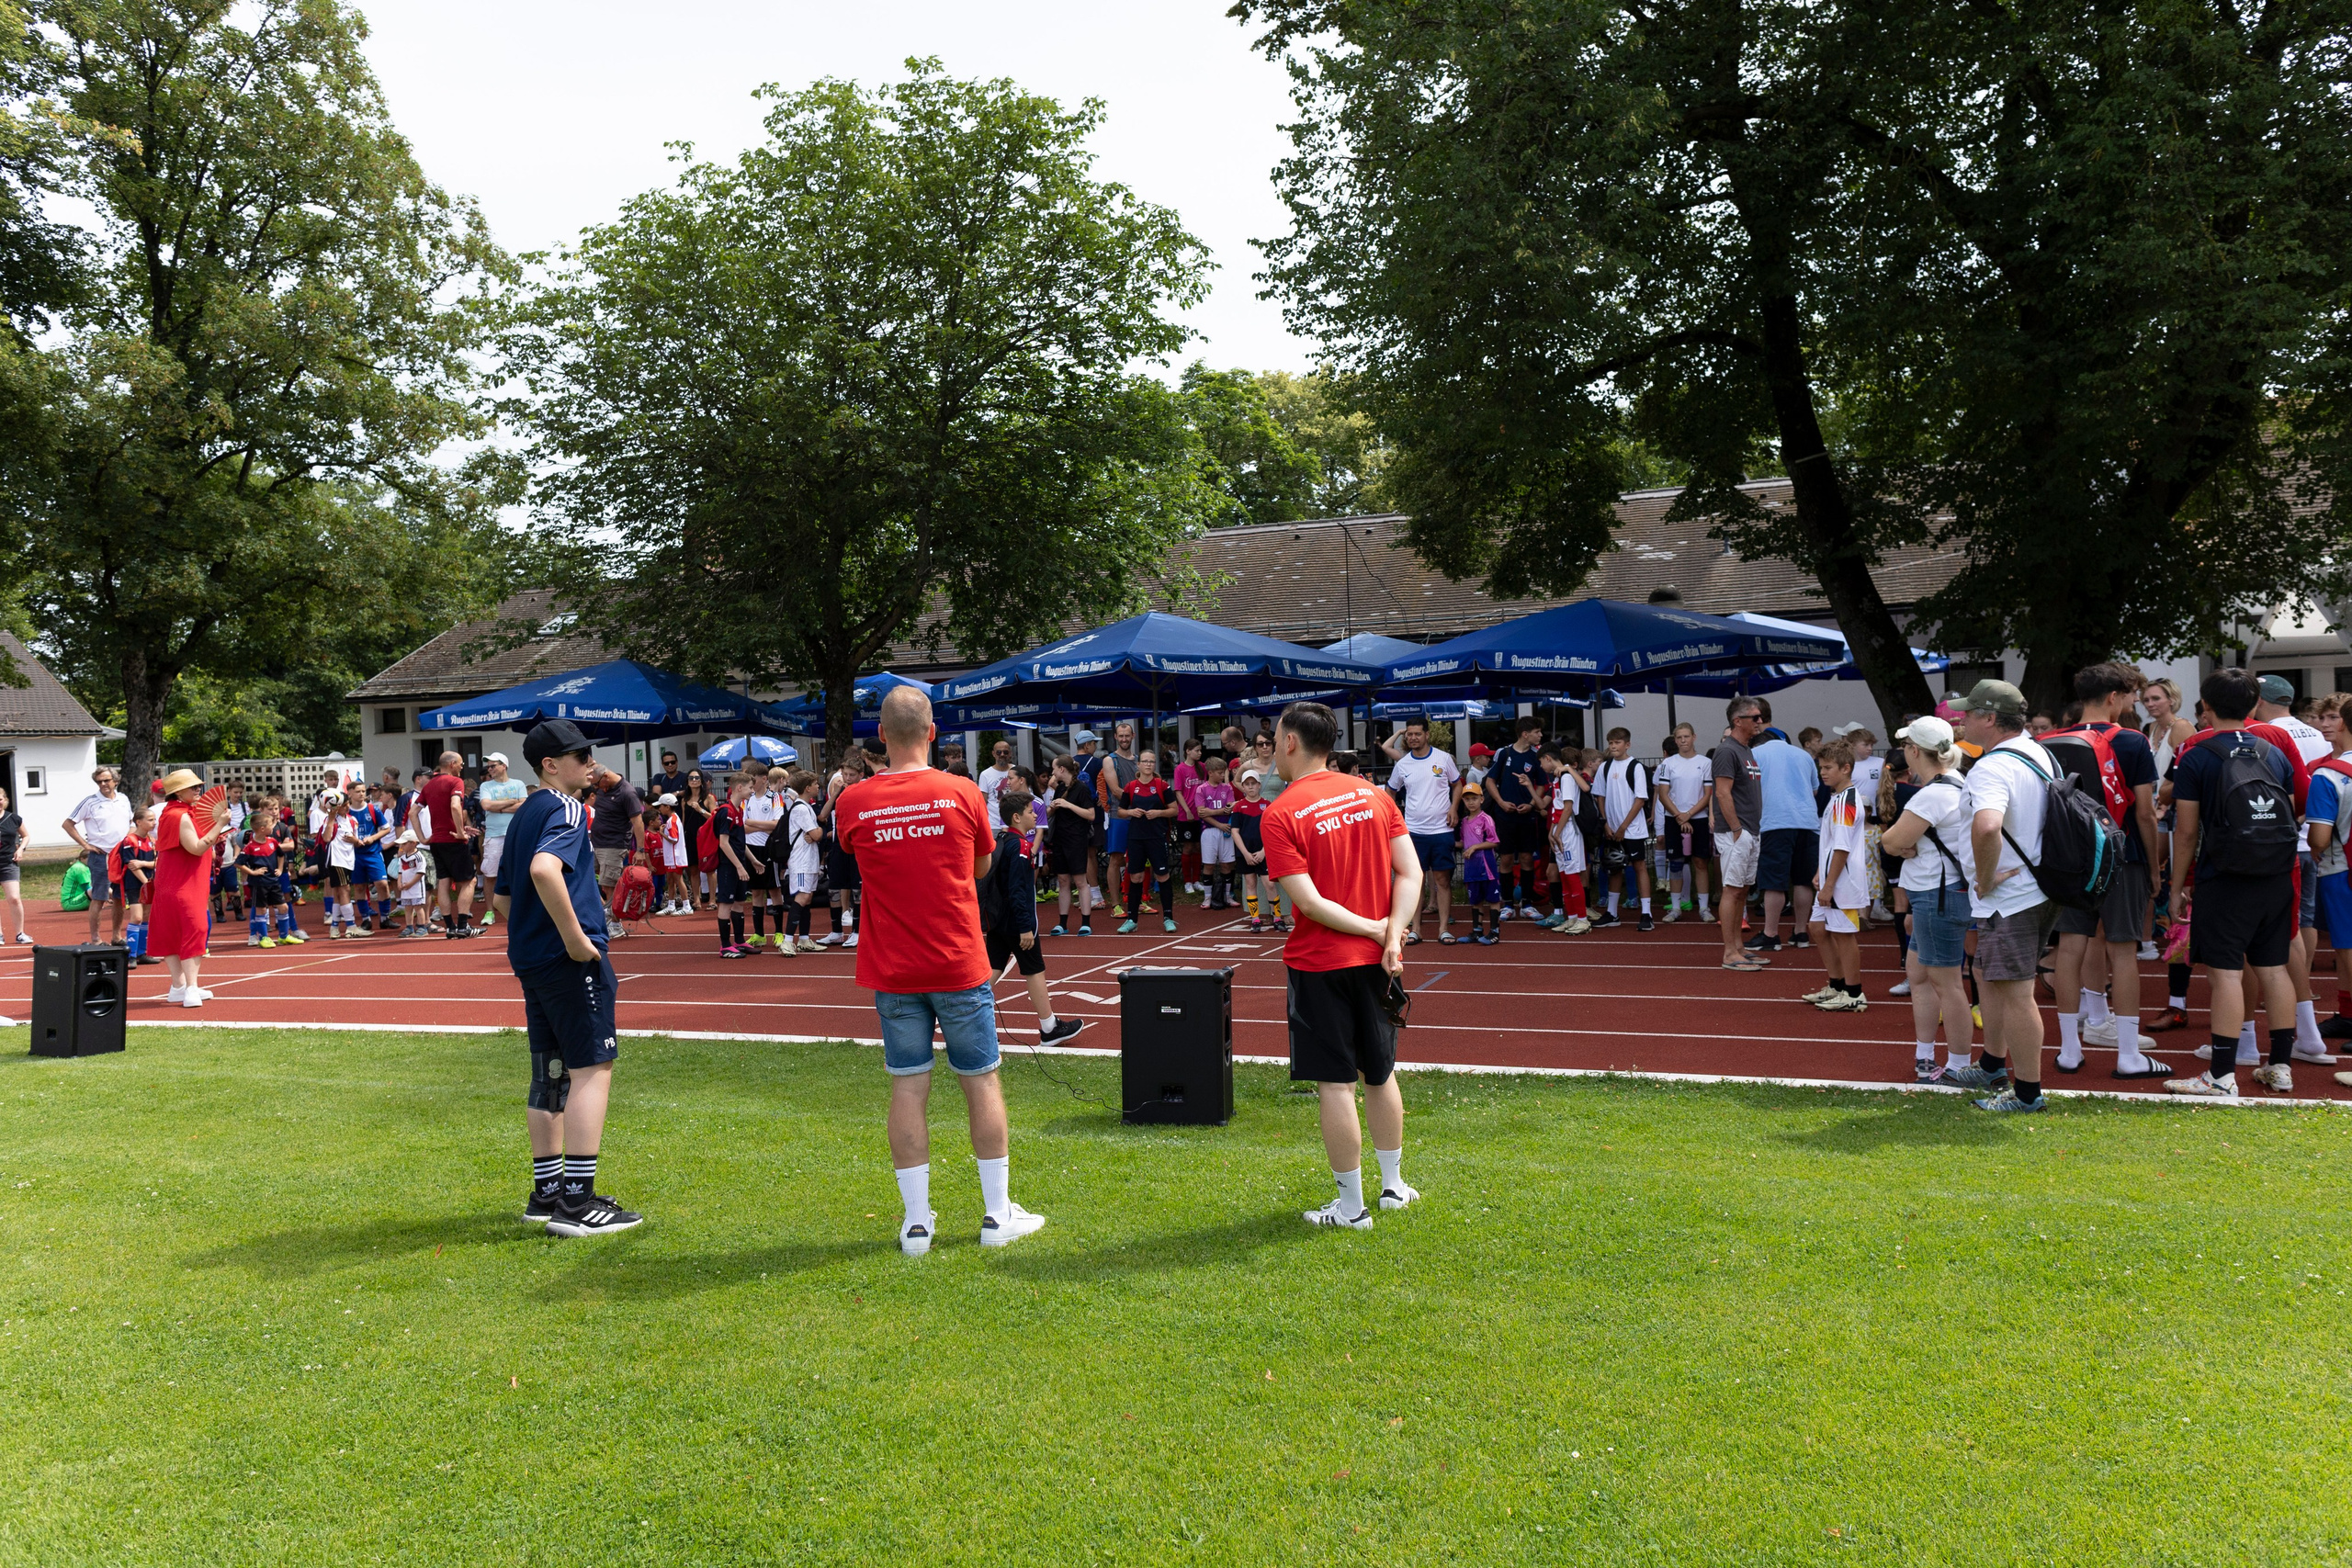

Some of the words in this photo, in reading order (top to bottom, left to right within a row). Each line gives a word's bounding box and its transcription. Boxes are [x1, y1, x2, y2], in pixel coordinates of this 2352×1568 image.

[1699, 643, 1724, 655] München
[1160, 658, 1219, 673] Augustiner-Bräu
[1218, 660, 1249, 671] München
[1511, 654, 1569, 670] Augustiner-Bräu
[1569, 657, 1598, 670] München
[1296, 663, 1346, 679] Augustiner-Bräu
[1345, 669, 1371, 682] München
[573, 706, 627, 719] Augustiner-Bräu
[858, 803, 931, 820] Generationencup
[933, 798, 956, 809] 2024
[1213, 800, 1222, 809] 10
[1294, 792, 1356, 819] Generationencup
[875, 812, 941, 826] #menzinggemeinsam
[1315, 816, 1341, 835] SVU
[1342, 808, 1374, 825] Crew
[2251, 812, 2277, 820] adidas
[874, 827, 903, 843] SVU
[907, 825, 945, 838] Crew
[604, 1036, 616, 1050] PB
